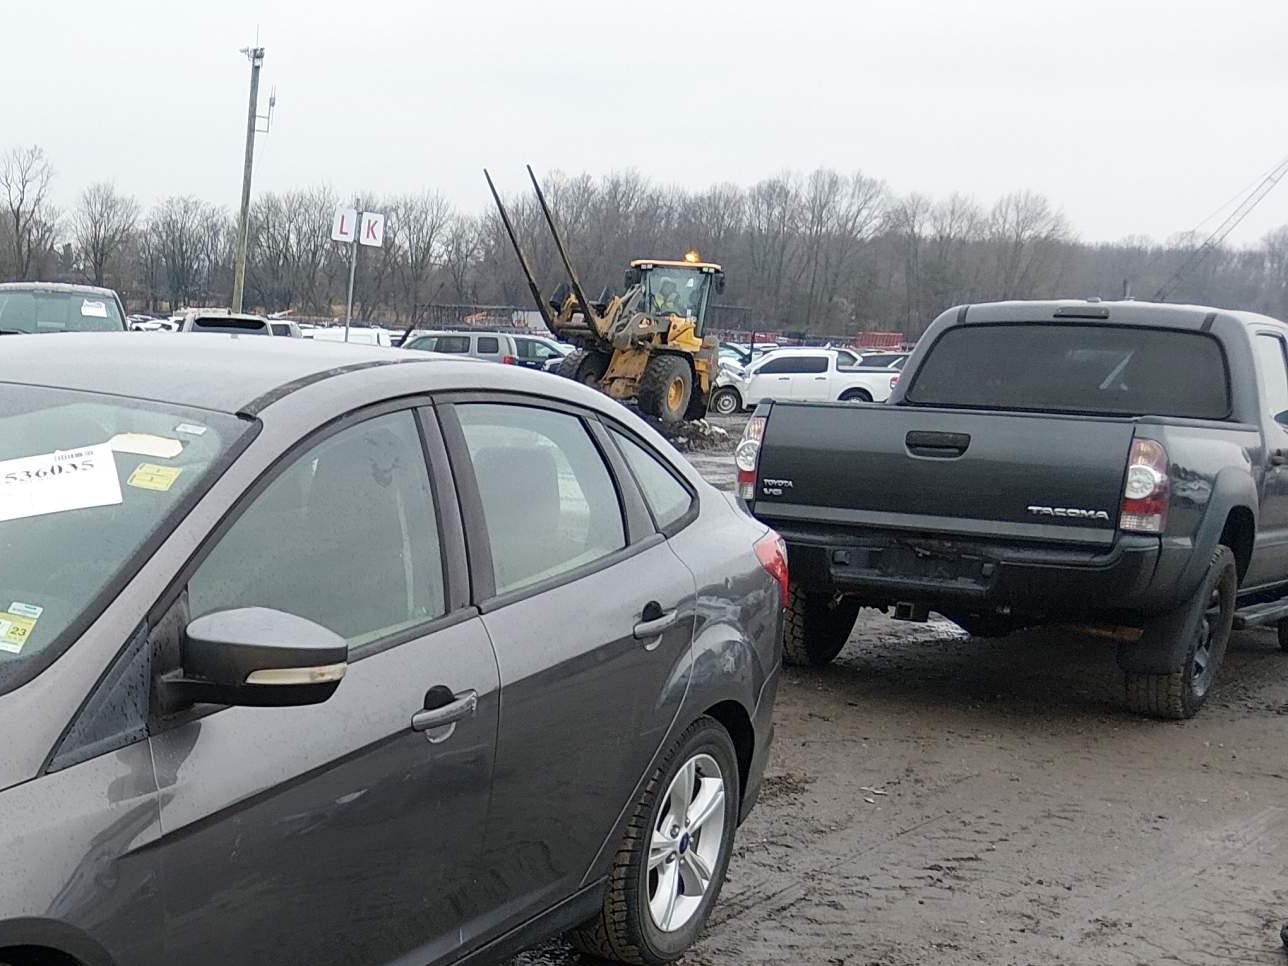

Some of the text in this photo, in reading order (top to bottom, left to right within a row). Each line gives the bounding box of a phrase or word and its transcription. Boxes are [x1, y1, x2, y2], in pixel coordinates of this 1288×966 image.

[339, 214, 349, 236] L
[365, 219, 378, 240] K
[763, 478, 794, 488] TOYOTA
[763, 487, 783, 496] V6
[1027, 505, 1109, 520] TACOMA
[10, 626, 27, 636] 23
